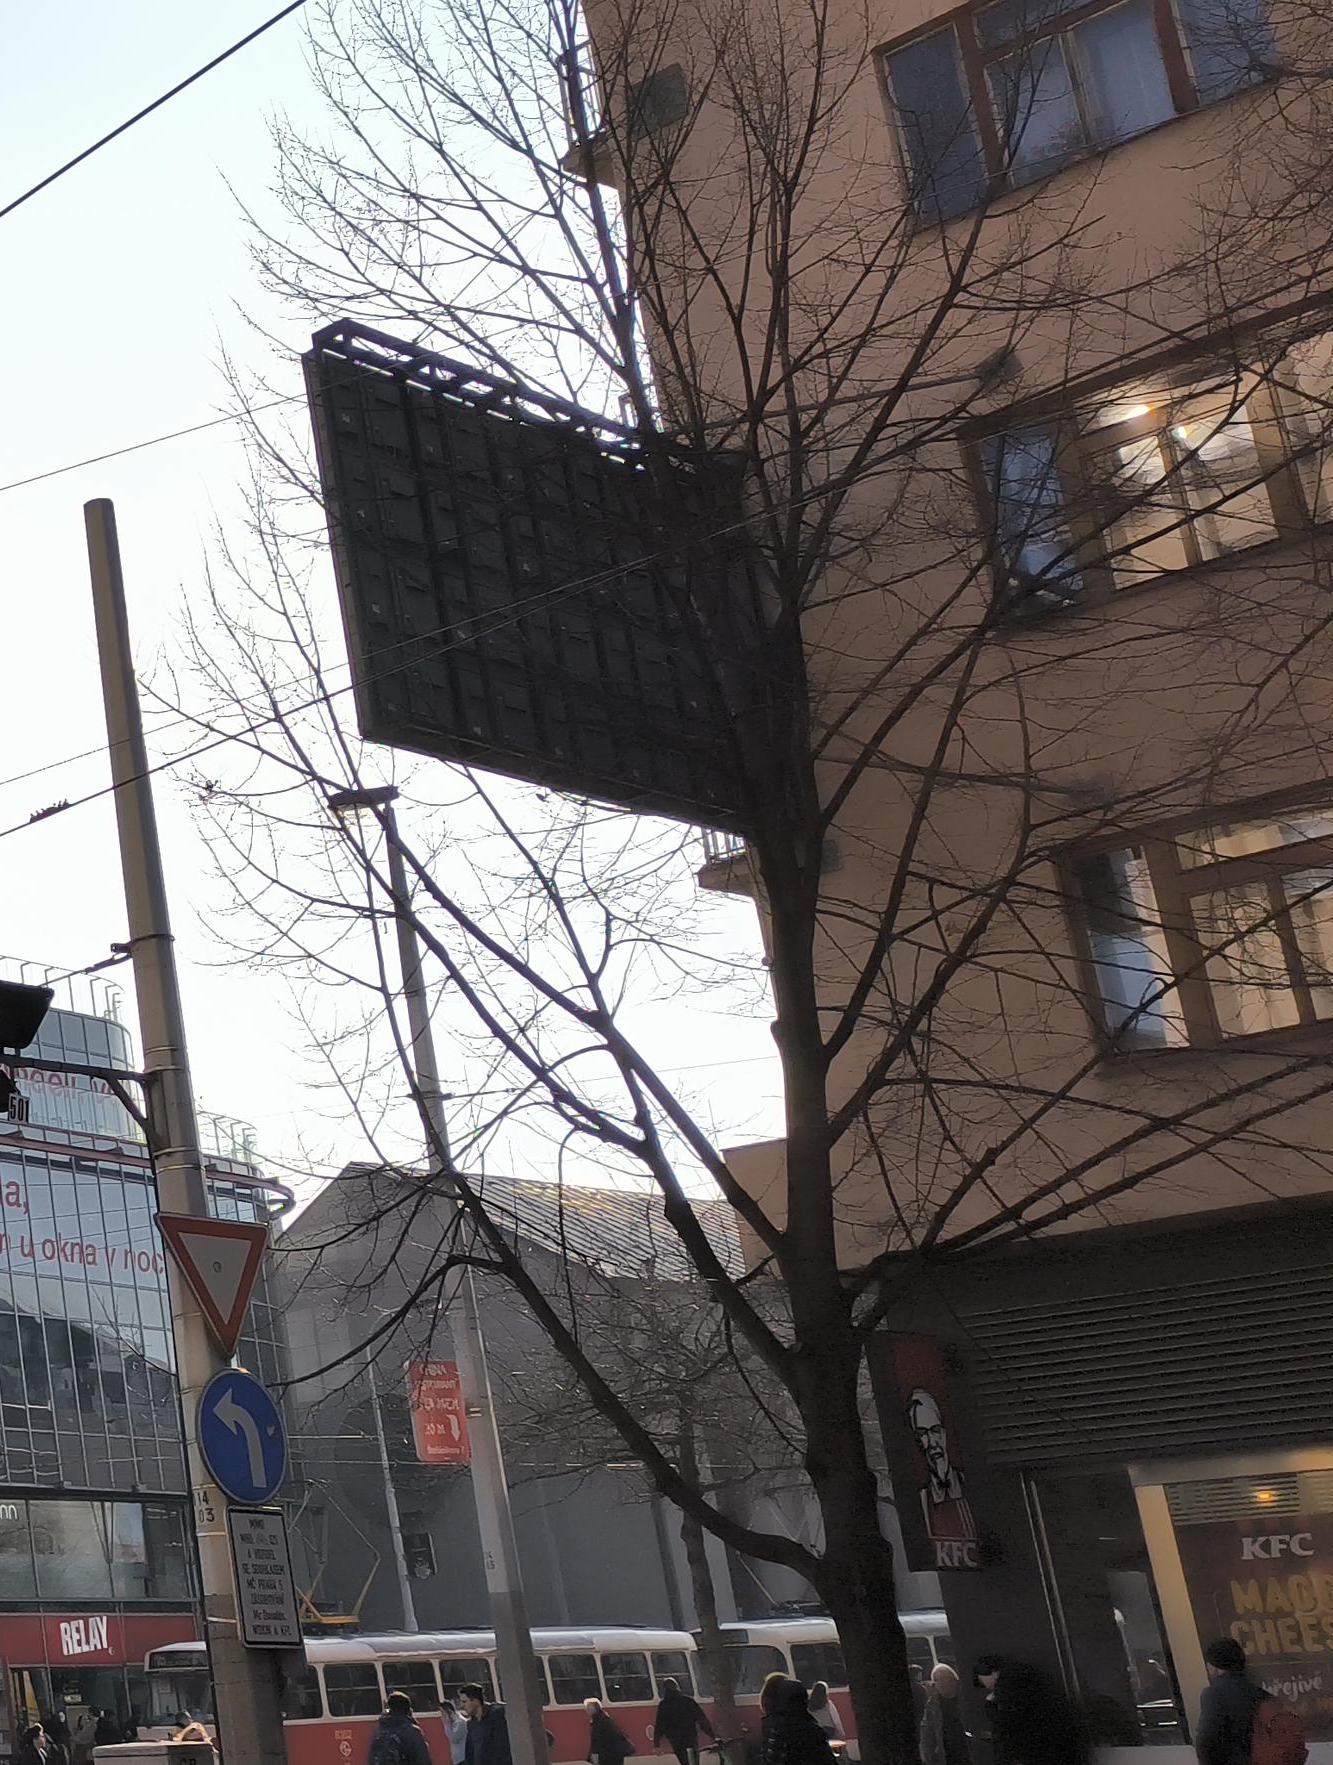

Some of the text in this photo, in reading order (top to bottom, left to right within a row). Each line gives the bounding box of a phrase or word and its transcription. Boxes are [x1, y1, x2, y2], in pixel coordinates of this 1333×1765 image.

[20, 1238, 34, 1261] u
[41, 1232, 98, 1268] okna
[934, 1541, 979, 1568] KFC
[1240, 1532, 1315, 1560] KFC
[59, 1615, 109, 1657] RELAY
